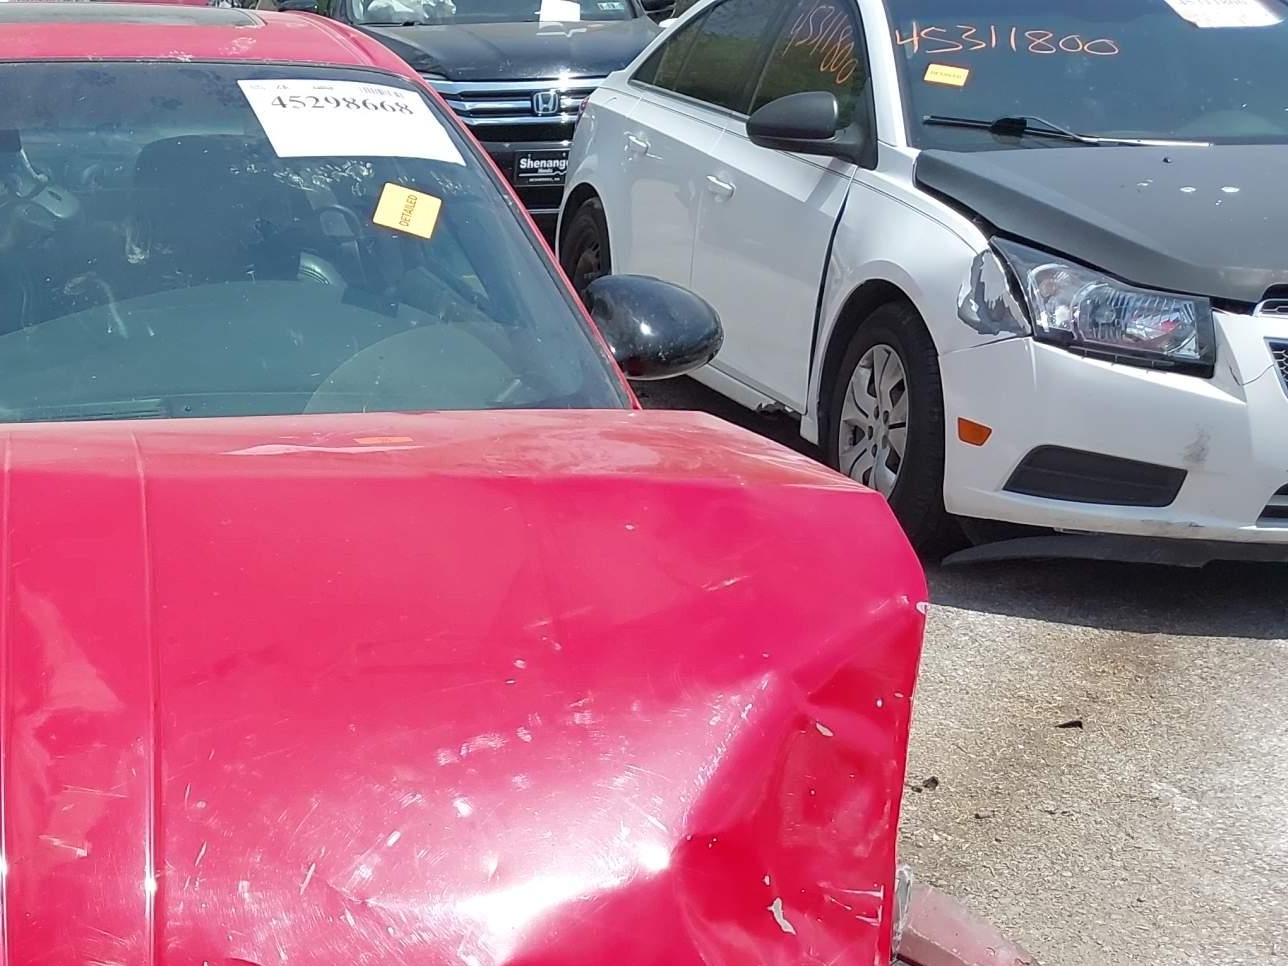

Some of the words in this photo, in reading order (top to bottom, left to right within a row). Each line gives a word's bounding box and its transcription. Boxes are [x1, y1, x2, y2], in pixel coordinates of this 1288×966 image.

[895, 21, 1120, 55] 45311800
[271, 95, 414, 115] 45298668
[398, 194, 418, 227] DETAILED
